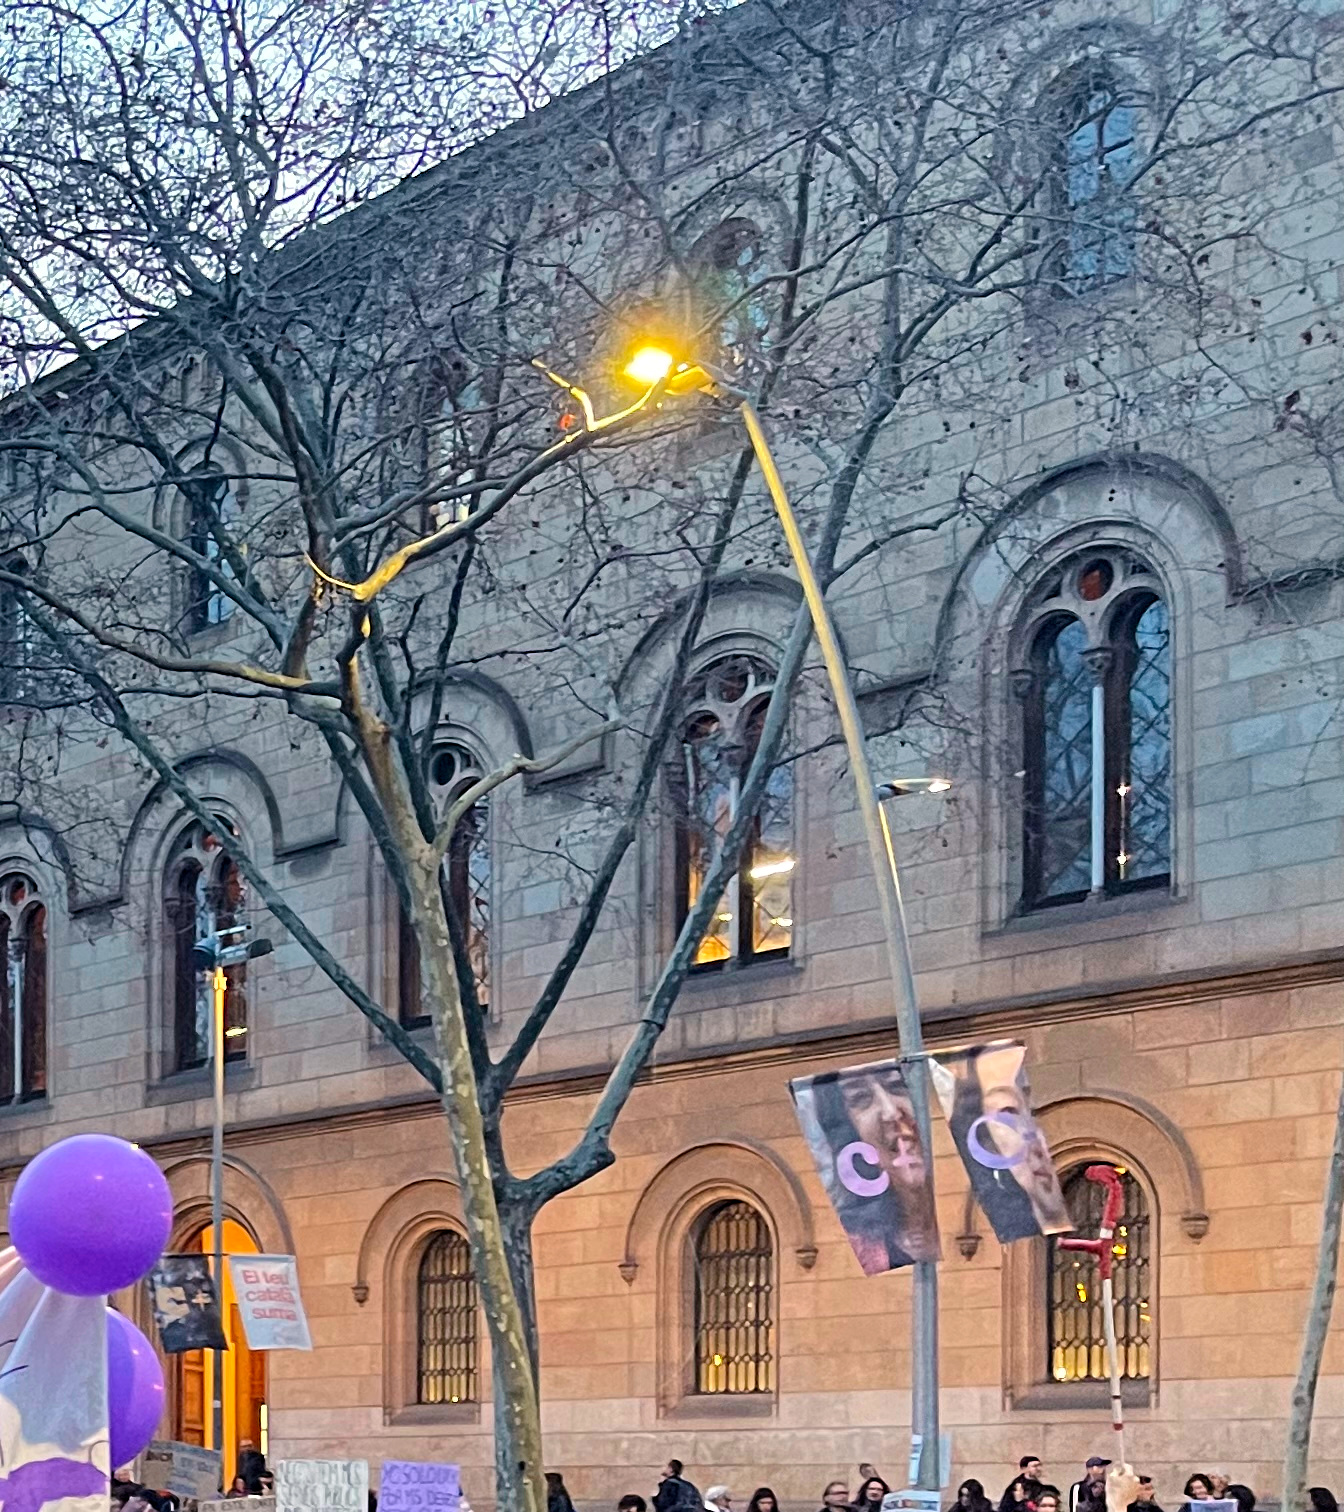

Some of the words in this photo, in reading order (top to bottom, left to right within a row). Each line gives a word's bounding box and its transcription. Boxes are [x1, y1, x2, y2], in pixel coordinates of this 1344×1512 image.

[242, 1269, 260, 1285] El
[262, 1271, 290, 1286] teu
[245, 1287, 296, 1304] català
[252, 1307, 297, 1321] suma
